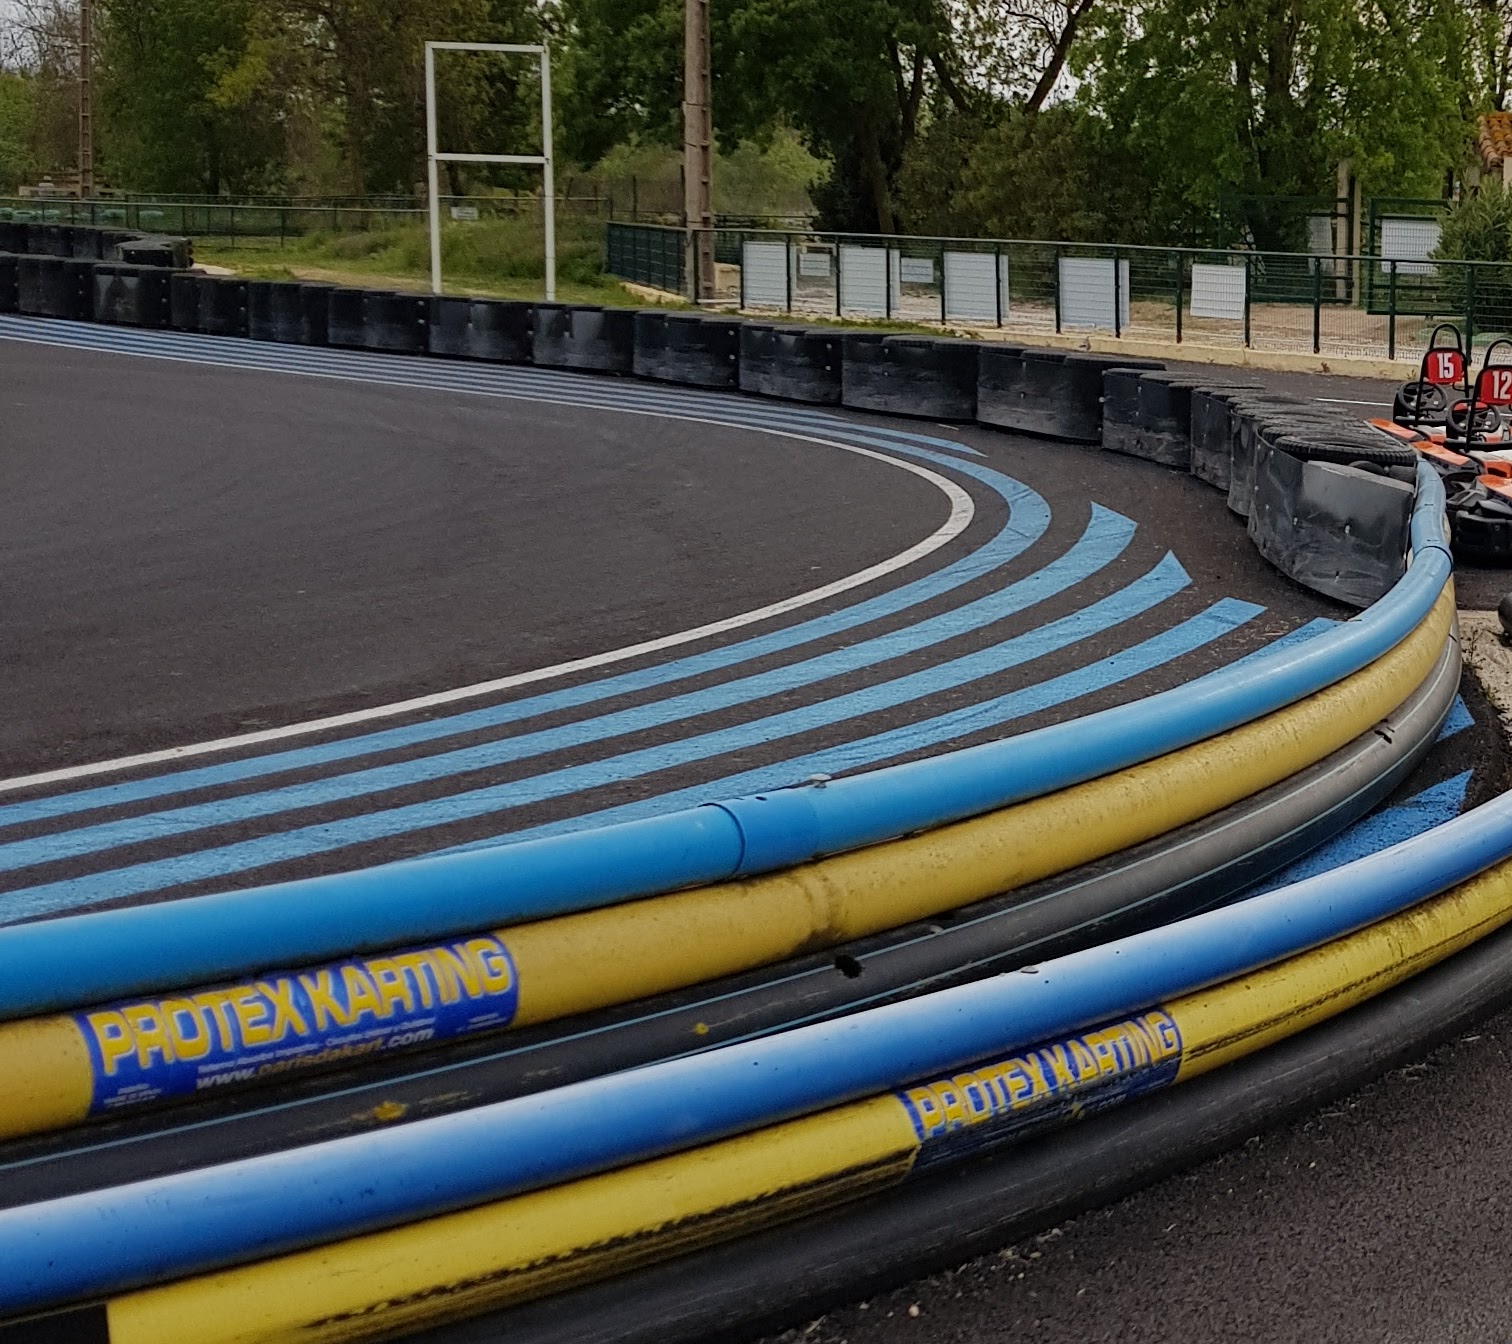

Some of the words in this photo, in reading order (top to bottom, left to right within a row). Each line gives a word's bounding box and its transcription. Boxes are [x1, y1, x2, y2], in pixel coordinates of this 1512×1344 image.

[1436, 352, 1455, 379] 15
[1492, 370, 1512, 400] 12
[87, 979, 305, 1076] PROTEX
[304, 936, 512, 1030] KARTING
[905, 1052, 1050, 1138] PROTEX
[1044, 1010, 1179, 1093] KARTING
